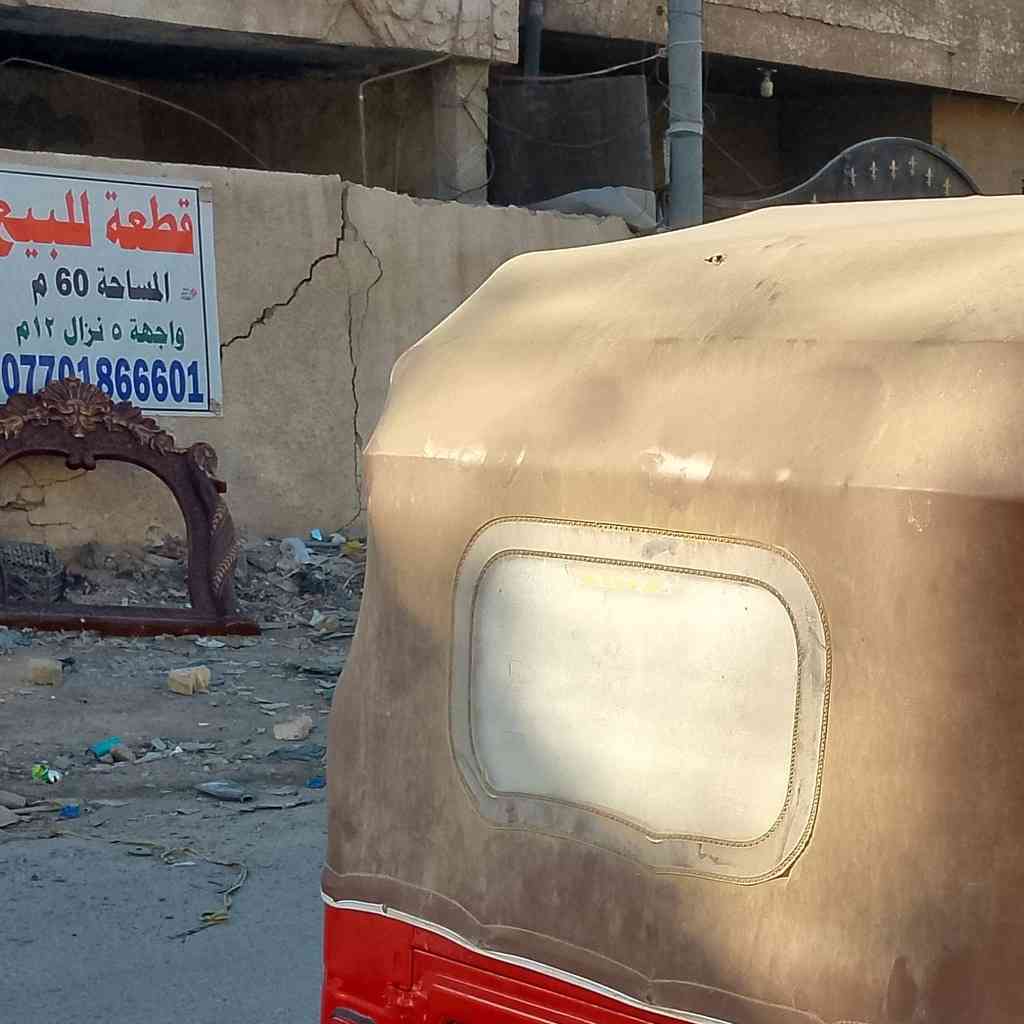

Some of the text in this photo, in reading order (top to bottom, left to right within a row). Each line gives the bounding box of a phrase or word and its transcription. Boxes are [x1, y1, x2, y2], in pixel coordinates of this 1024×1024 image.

[105, 190, 194, 256] قطعة
[31, 272, 48, 306] م
[55, 267, 89, 298] 60
[97, 266, 170, 303] المساحة
[63, 316, 105, 347] نزال
[129, 318, 185, 350] واجهة
